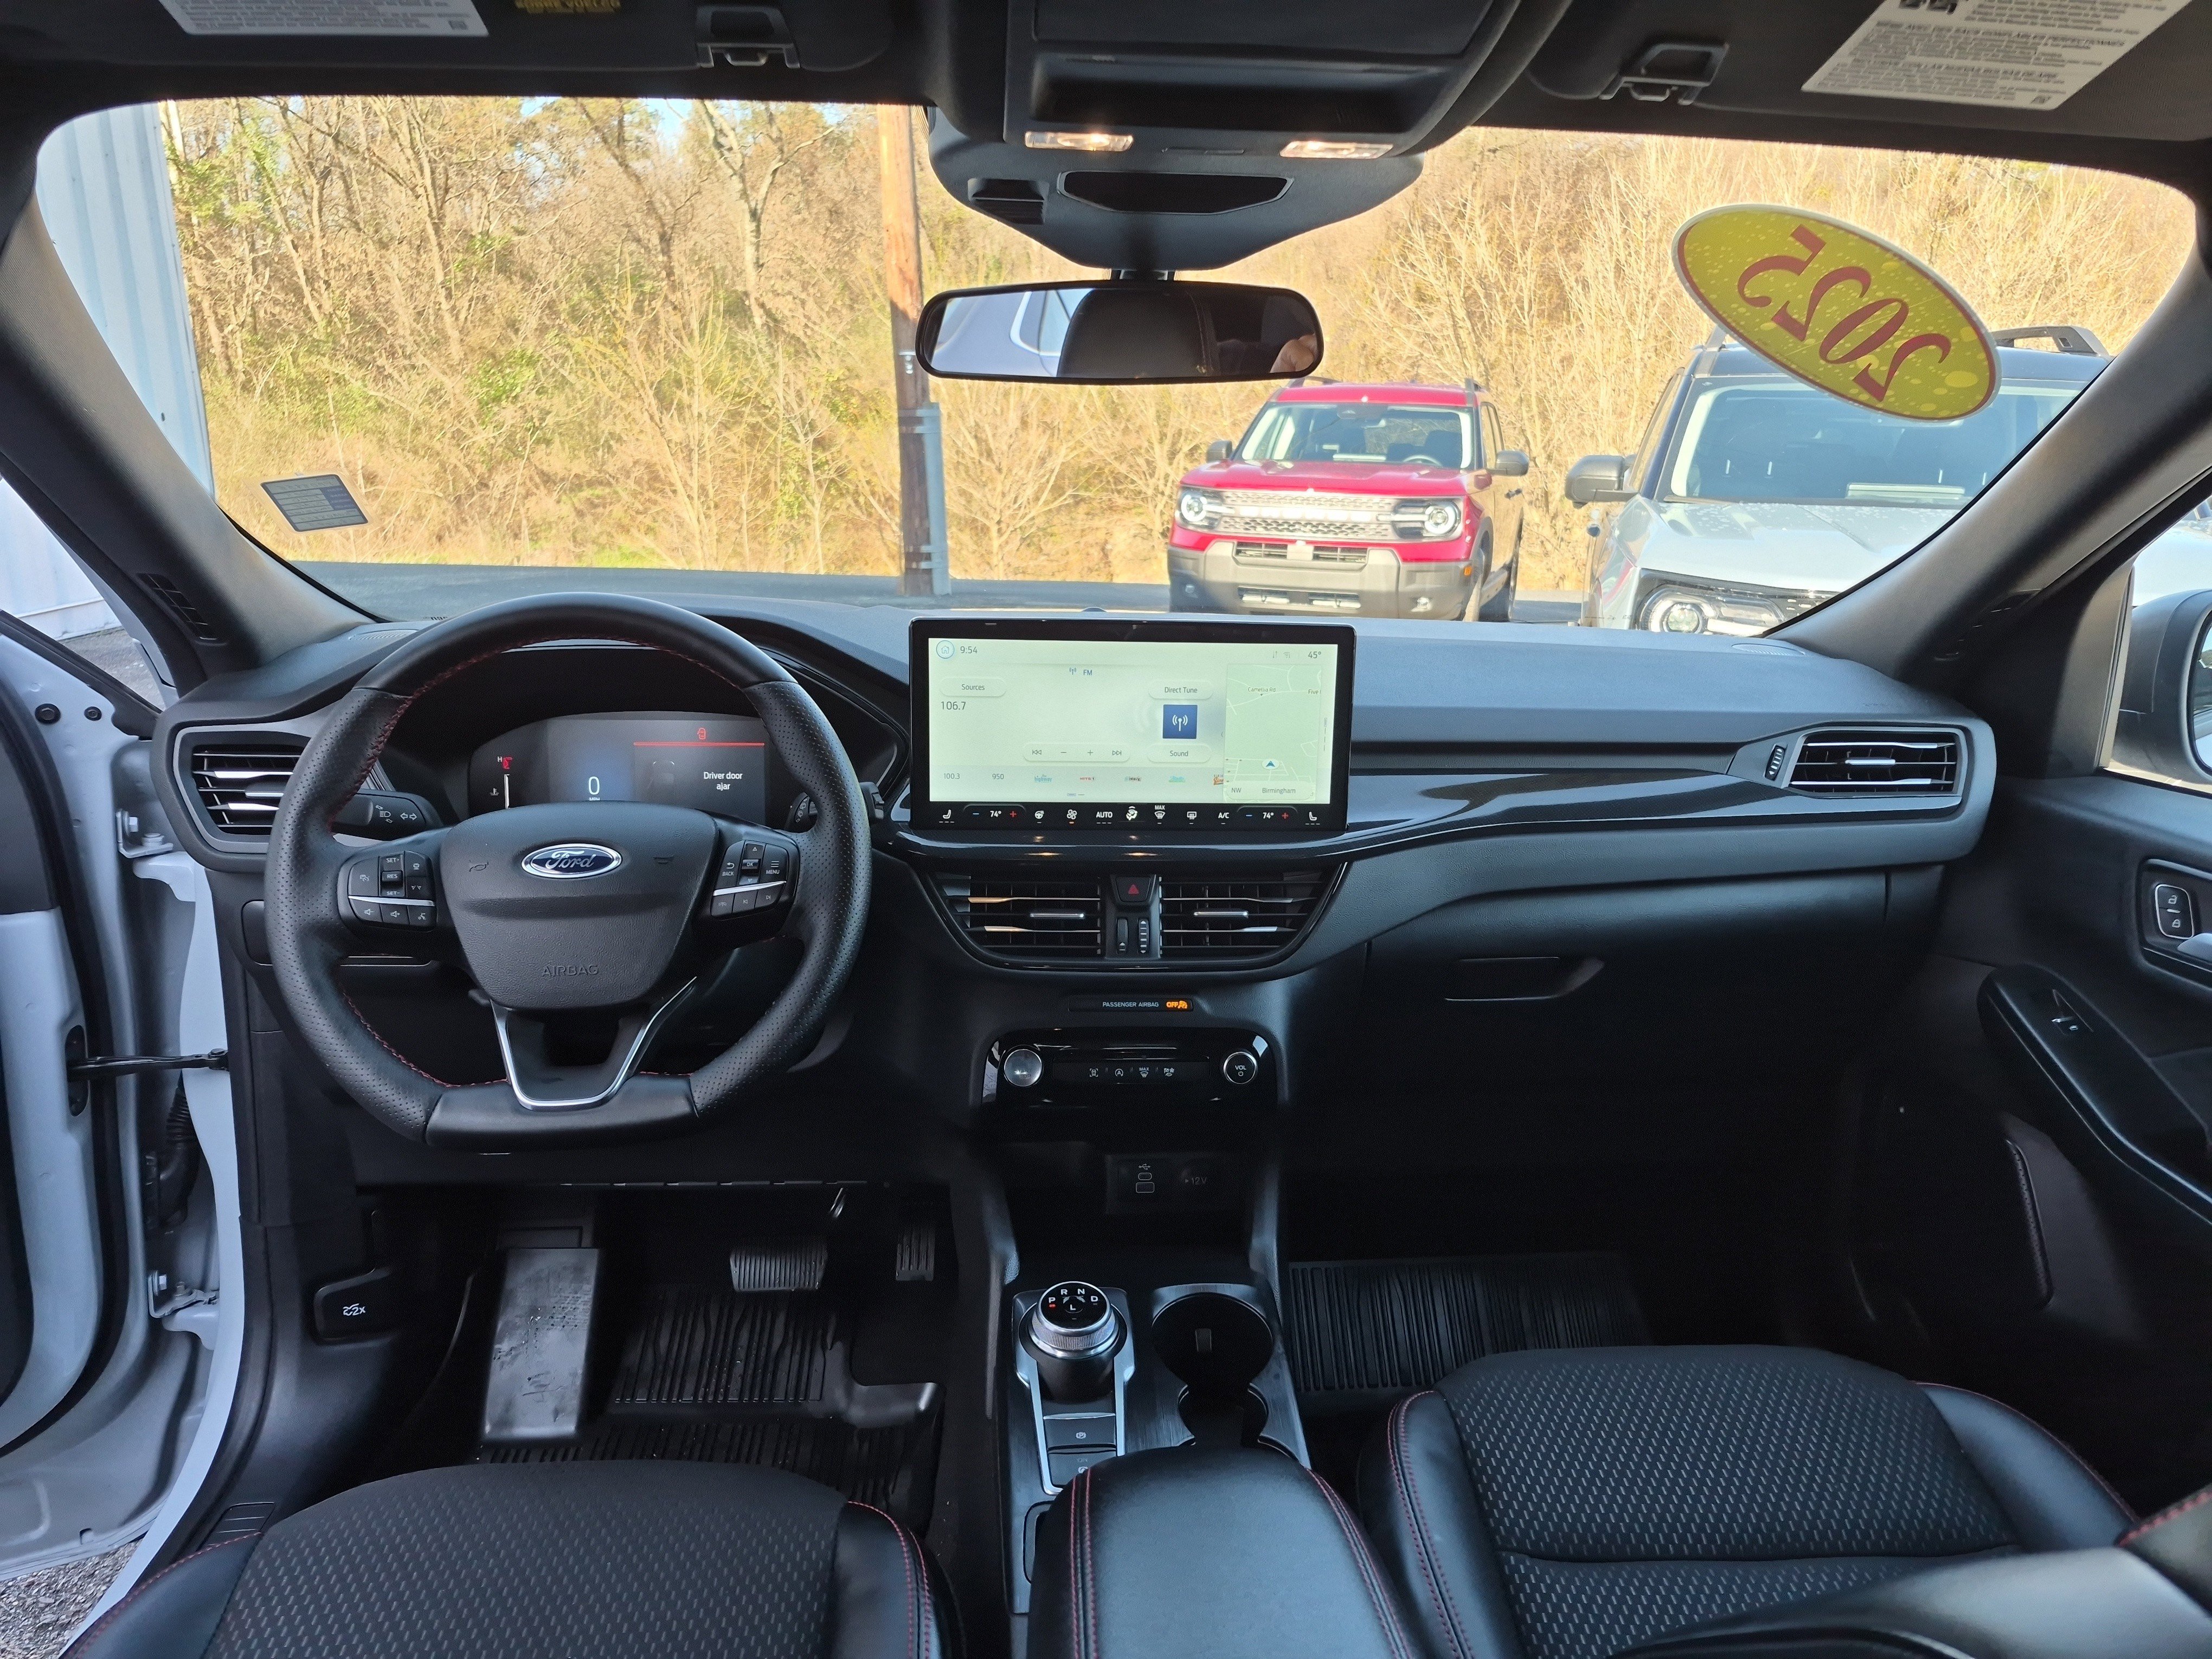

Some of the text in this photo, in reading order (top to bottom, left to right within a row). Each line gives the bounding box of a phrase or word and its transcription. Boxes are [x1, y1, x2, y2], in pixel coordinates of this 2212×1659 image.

[960, 646, 978, 654] 9:54
[1308, 651, 1322, 659] 45°
[941, 701, 966, 710] 106.7
[703, 771, 743, 780] Driver door
[588, 776, 600, 795] 0
[716, 782, 731, 791] ajar
[545, 850, 596, 869] Ford
[542, 964, 599, 977] AIRBAG
